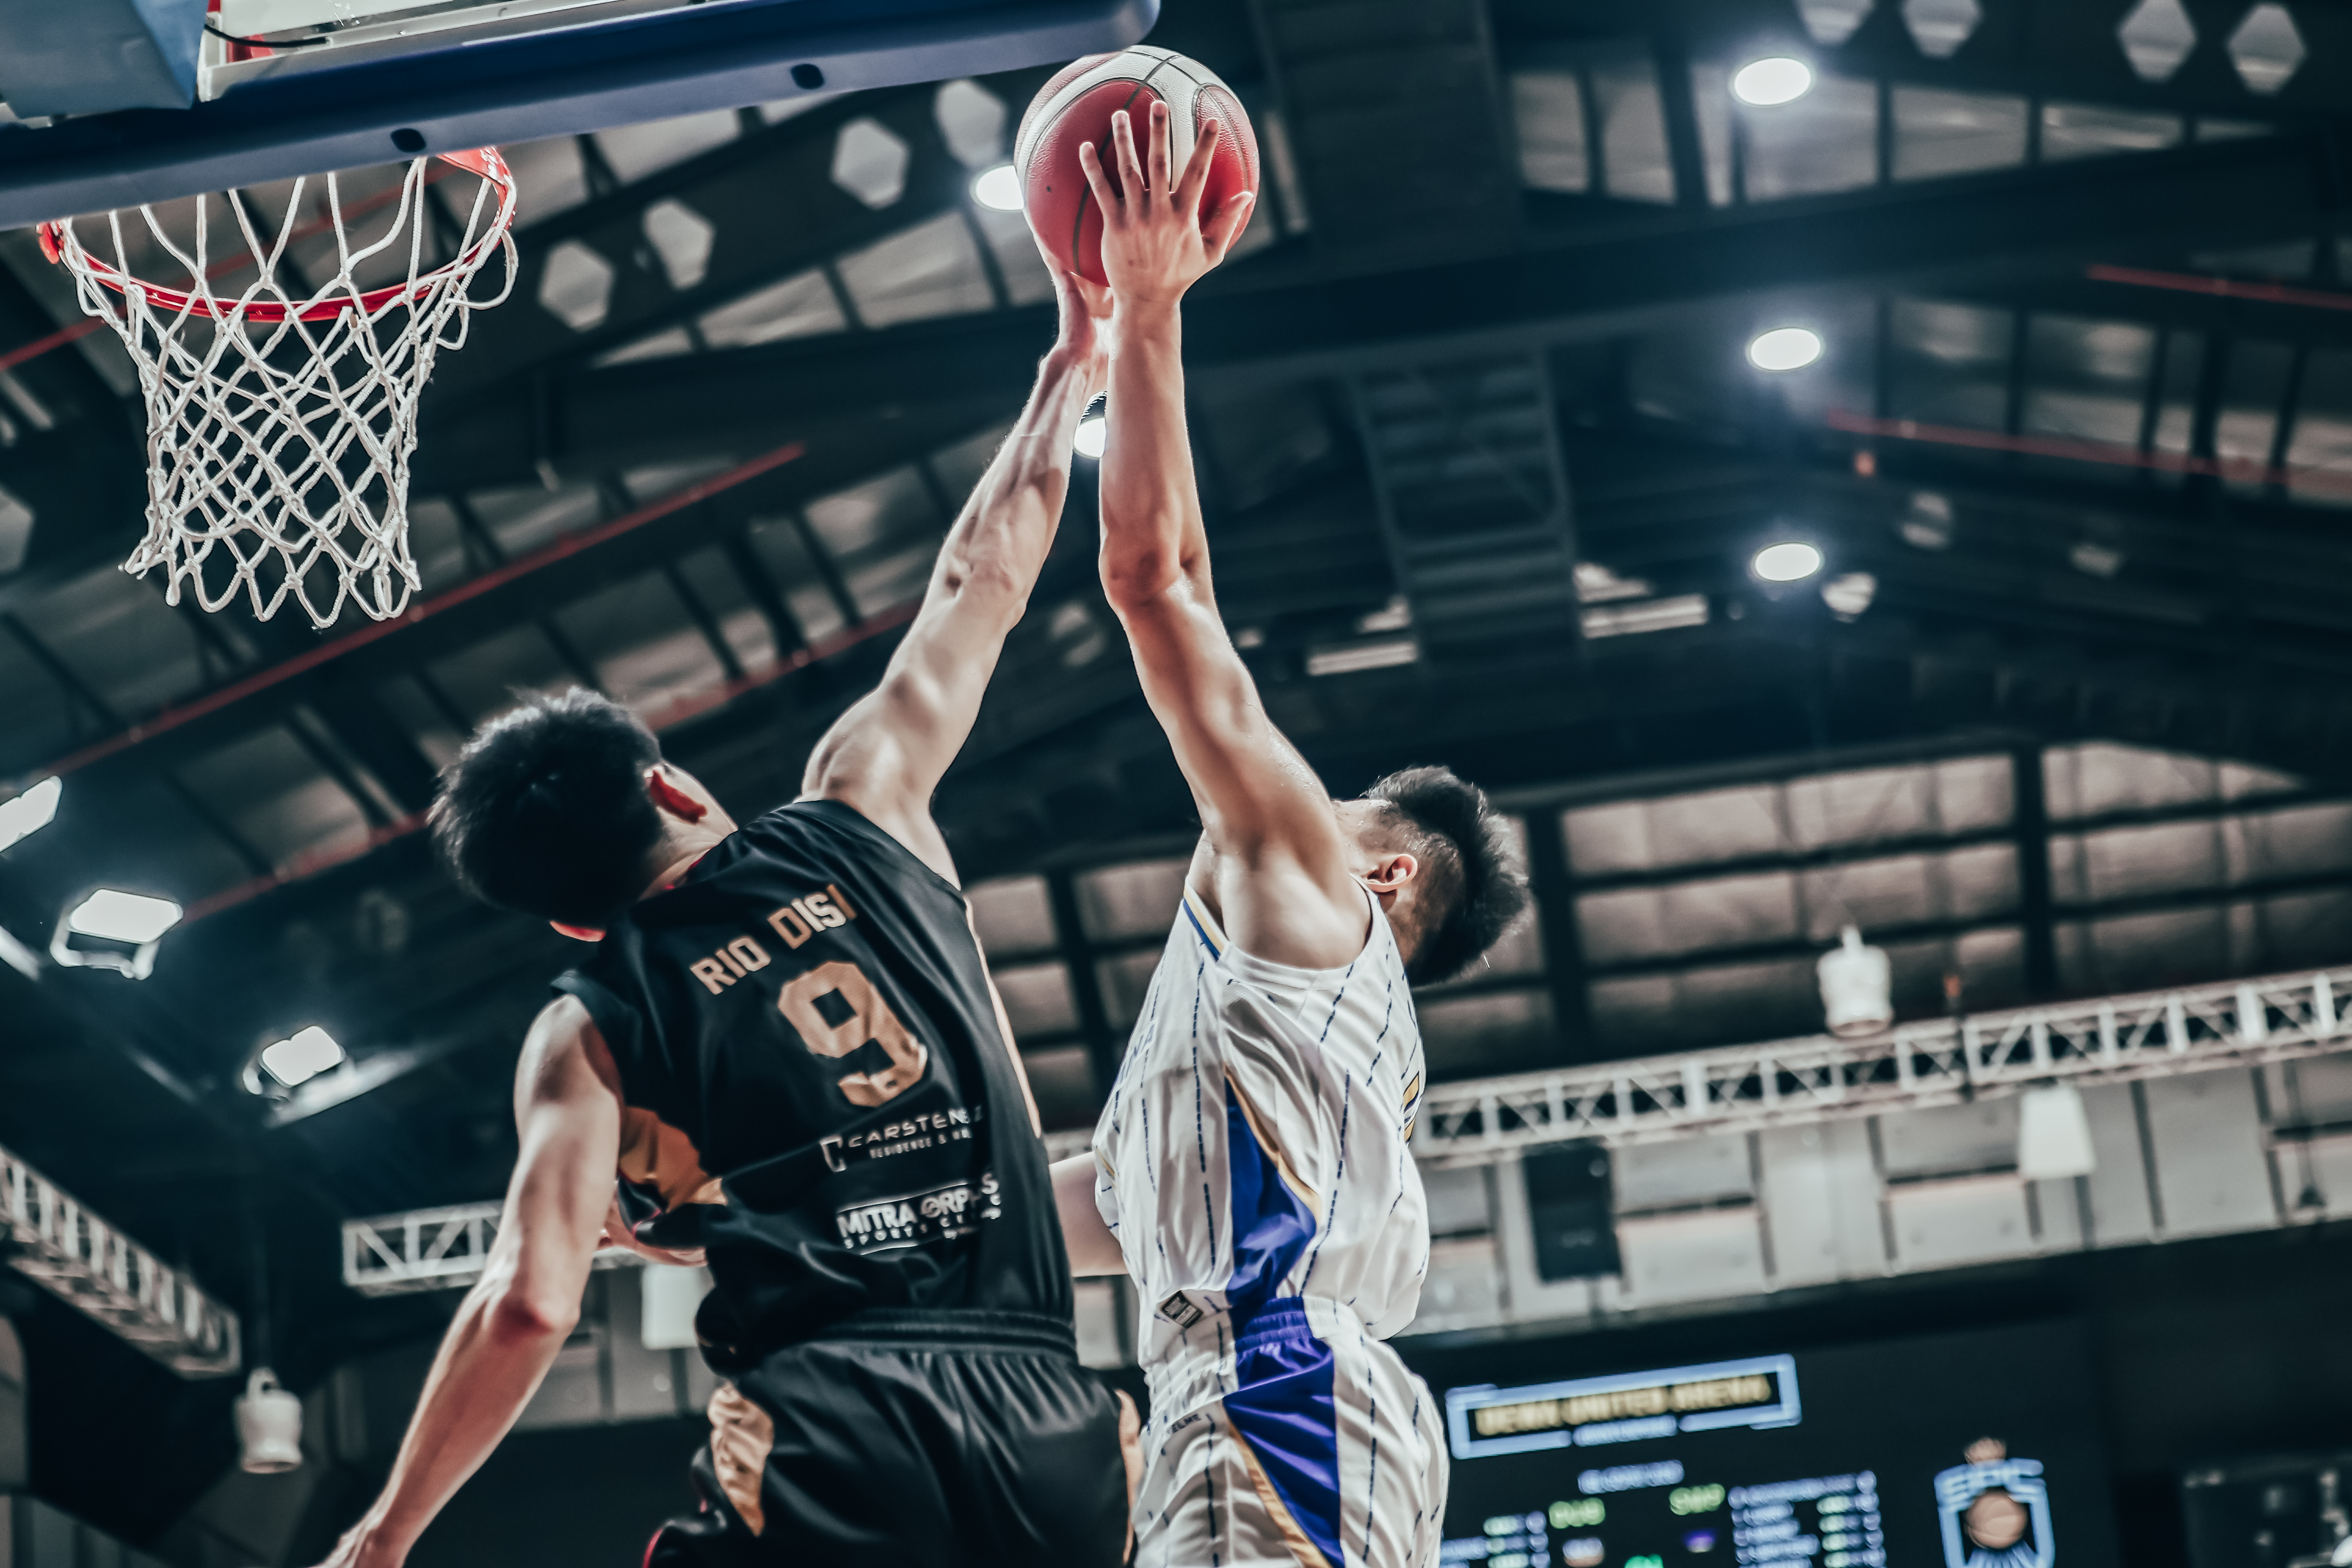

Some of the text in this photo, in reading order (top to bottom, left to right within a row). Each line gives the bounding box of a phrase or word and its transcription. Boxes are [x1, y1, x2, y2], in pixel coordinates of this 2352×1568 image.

[690, 884, 857, 995] RIO DISI
[777, 960, 928, 1107] 9
[836, 1203, 918, 1238] MITRA
[1167, 1414, 1201, 1434] ELME
